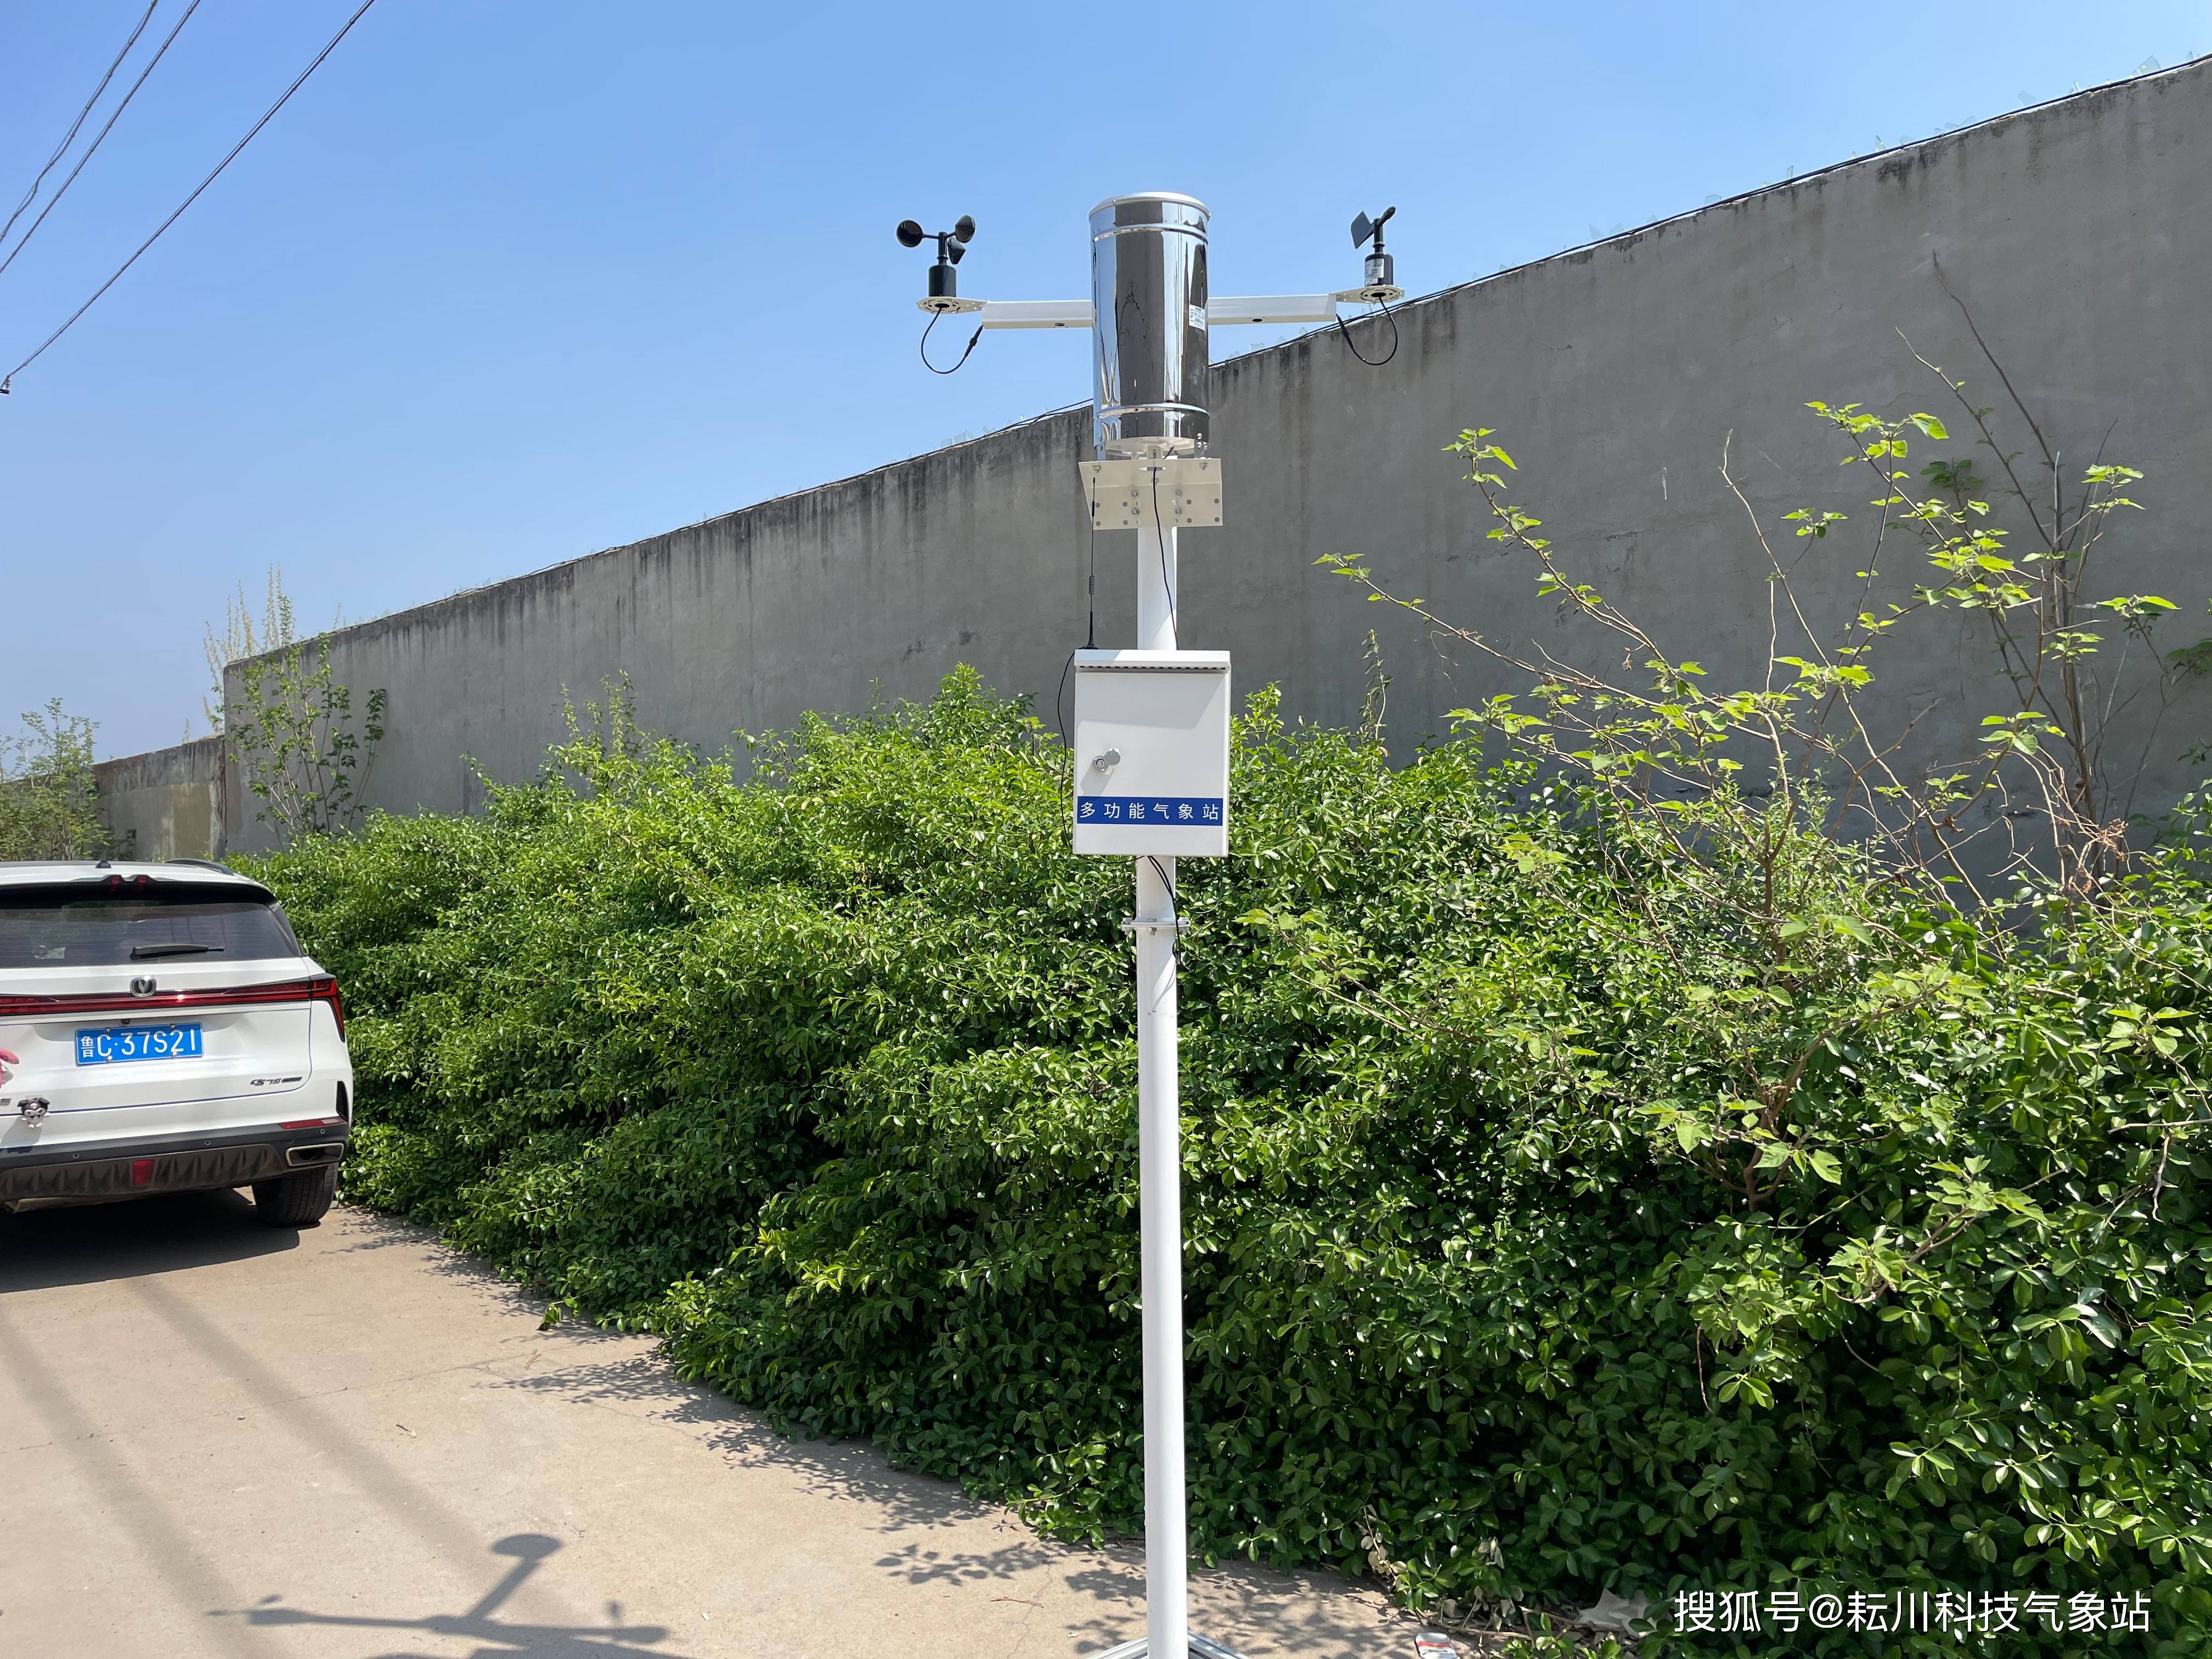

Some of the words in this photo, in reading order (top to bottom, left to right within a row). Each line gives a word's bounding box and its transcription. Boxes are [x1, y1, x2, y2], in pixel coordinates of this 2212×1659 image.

[1080, 802, 1218, 820] 多功能气象站
